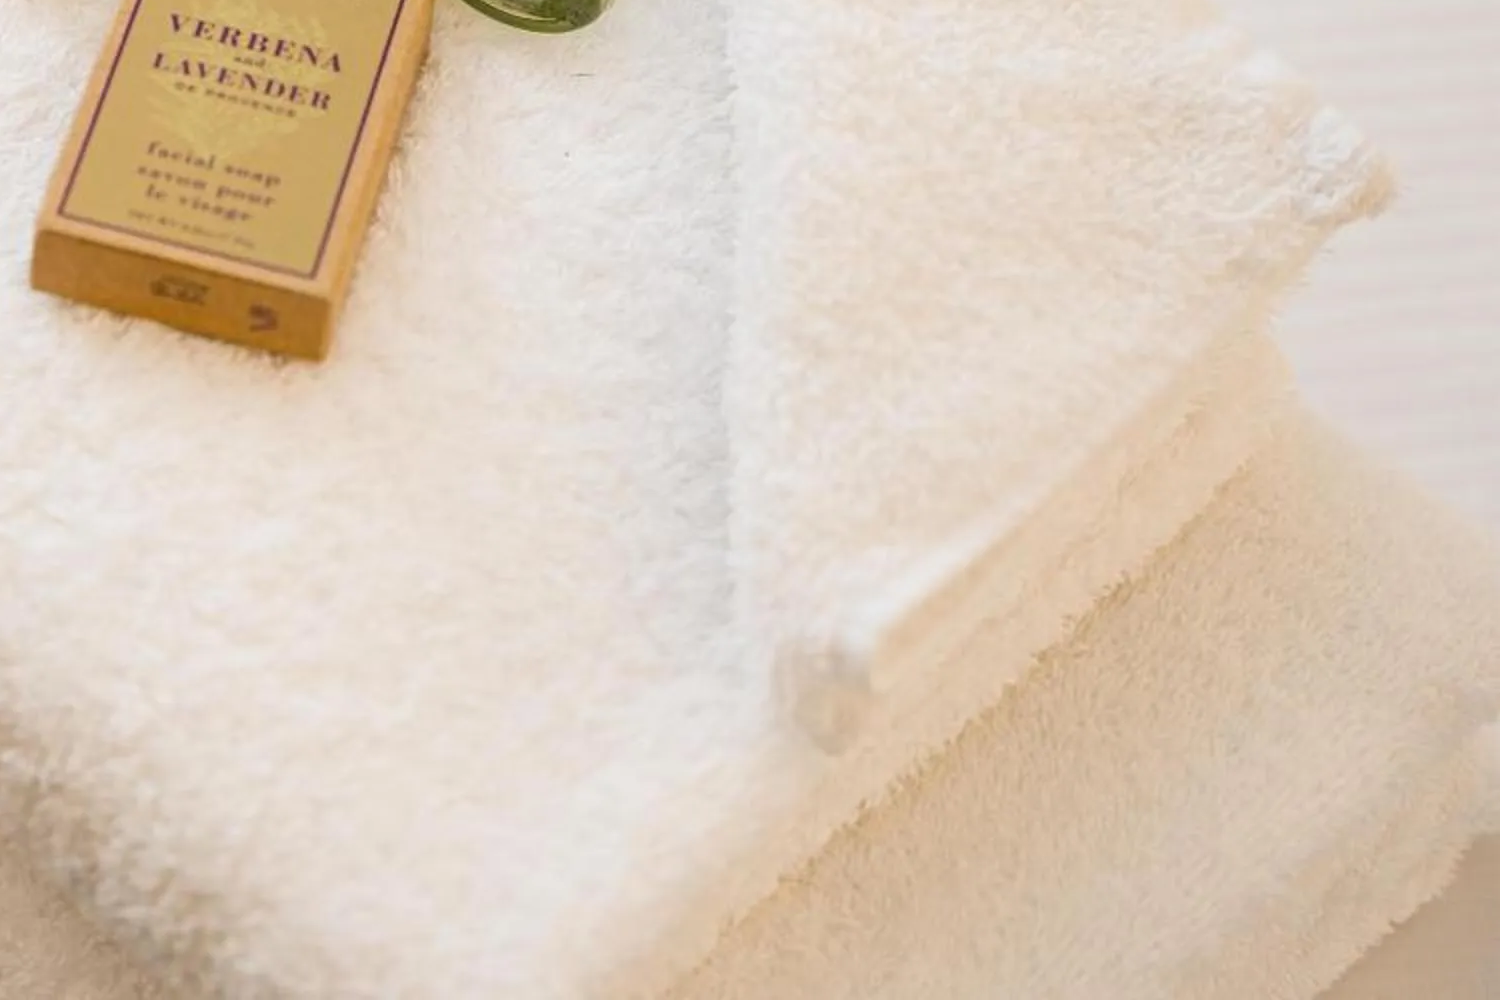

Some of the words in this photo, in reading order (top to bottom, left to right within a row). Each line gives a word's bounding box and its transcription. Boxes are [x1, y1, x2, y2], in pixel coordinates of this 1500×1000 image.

[170, 12, 341, 73] VERBENA
[233, 55, 267, 68] and
[152, 52, 331, 111] LAVENDER
[147, 140, 216, 171] facial
[225, 164, 282, 189] soap
[145, 182, 168, 199] le
[215, 185, 276, 208] pour
